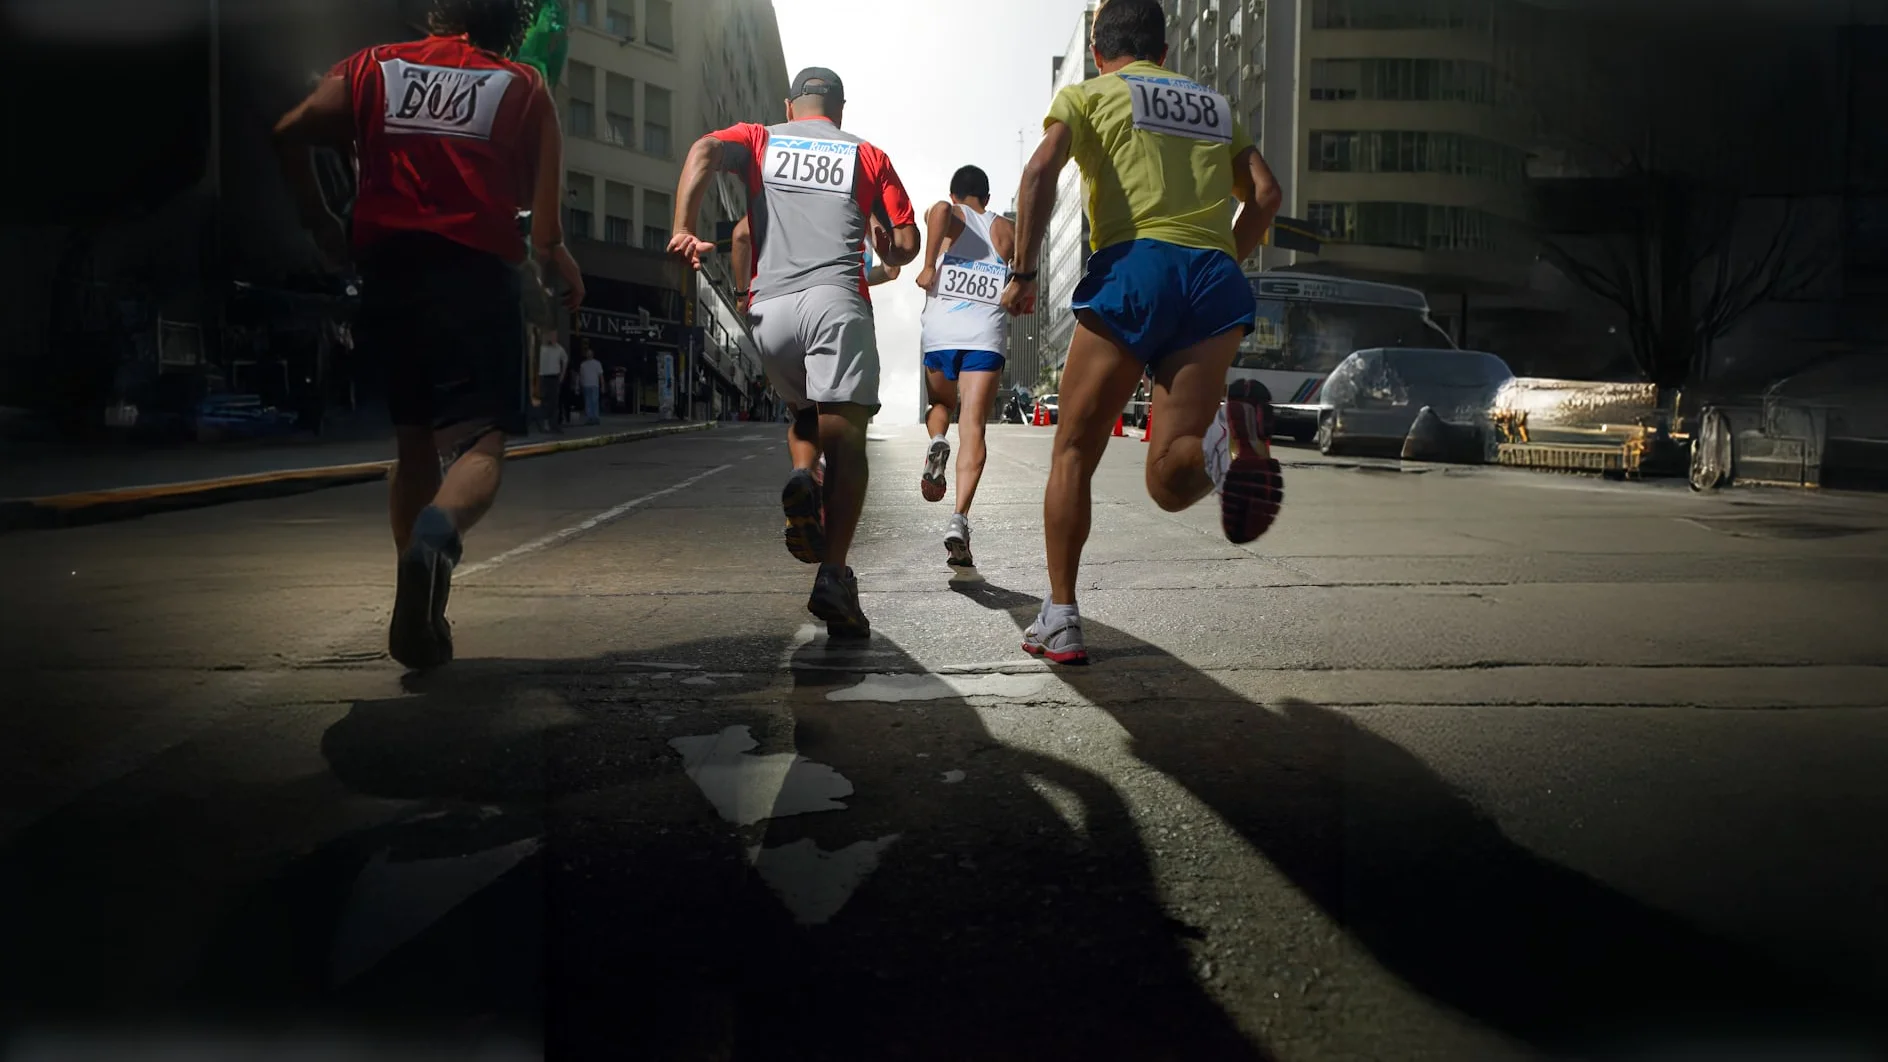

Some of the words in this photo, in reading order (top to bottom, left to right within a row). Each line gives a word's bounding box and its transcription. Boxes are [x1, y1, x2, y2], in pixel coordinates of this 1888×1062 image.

[1136, 84, 1219, 128] 16358
[809, 141, 857, 155] RunStyle
[774, 151, 844, 186] 21586
[945, 269, 999, 299] 32685
[577, 311, 665, 340] WINY
